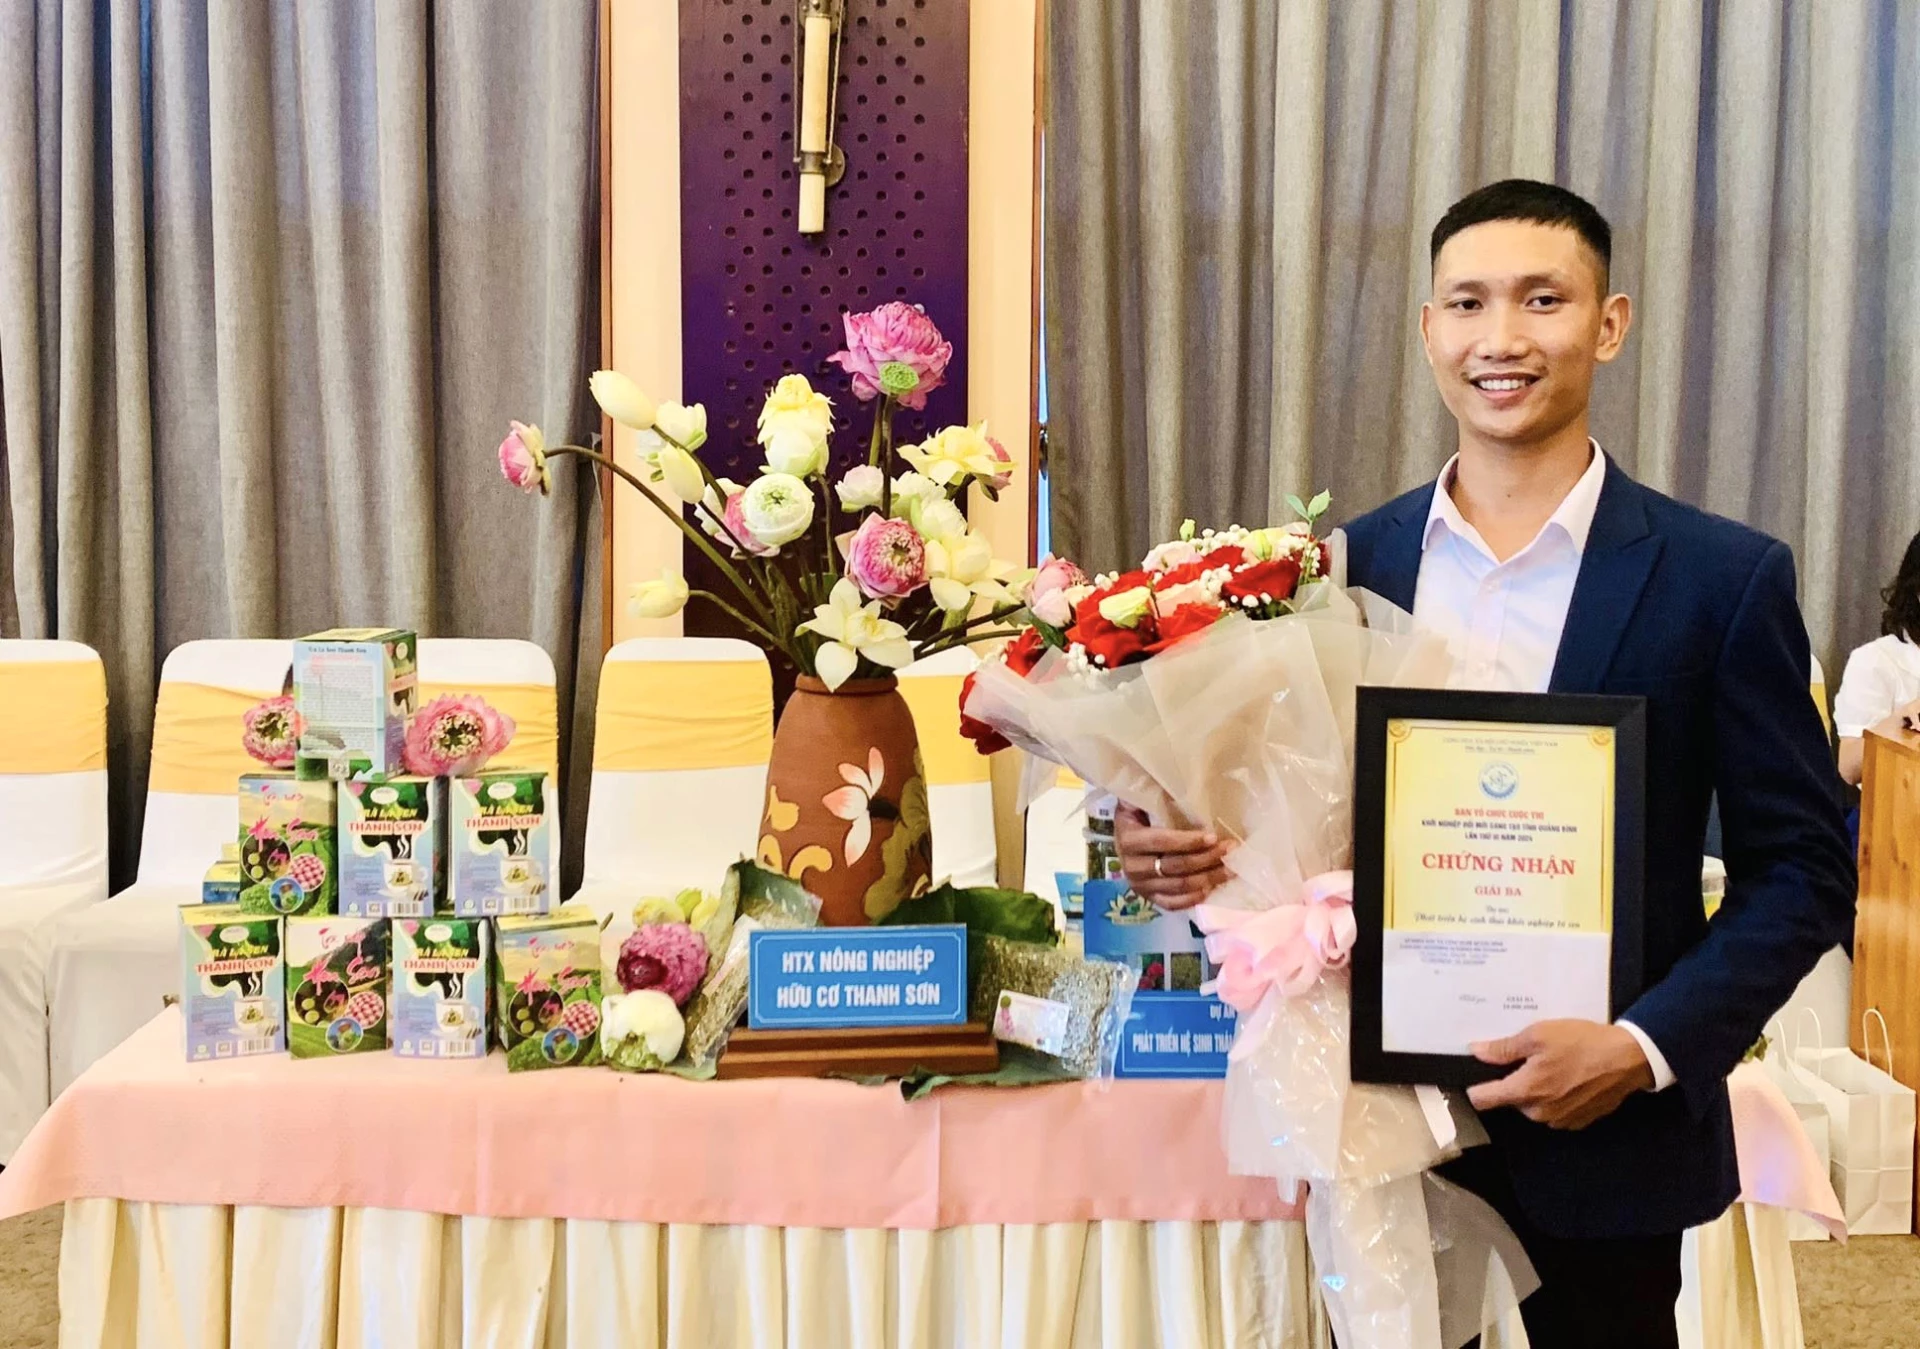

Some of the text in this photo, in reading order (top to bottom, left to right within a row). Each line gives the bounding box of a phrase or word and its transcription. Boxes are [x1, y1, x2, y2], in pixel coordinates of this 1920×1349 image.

[1422, 852, 1576, 879] CHỨNG NHẬN
[1505, 886, 1522, 897] BA
[782, 944, 935, 975] HTX NÔNG NGHIỆP
[777, 982, 940, 1008] HỮU CƠ THANH SƠN
[1132, 1029, 1153, 1054] PHÁT
[1155, 1026, 1179, 1054] TRIỂN
[1180, 1029, 1191, 1058] HỆ
[1193, 1033, 1213, 1054] SINH
